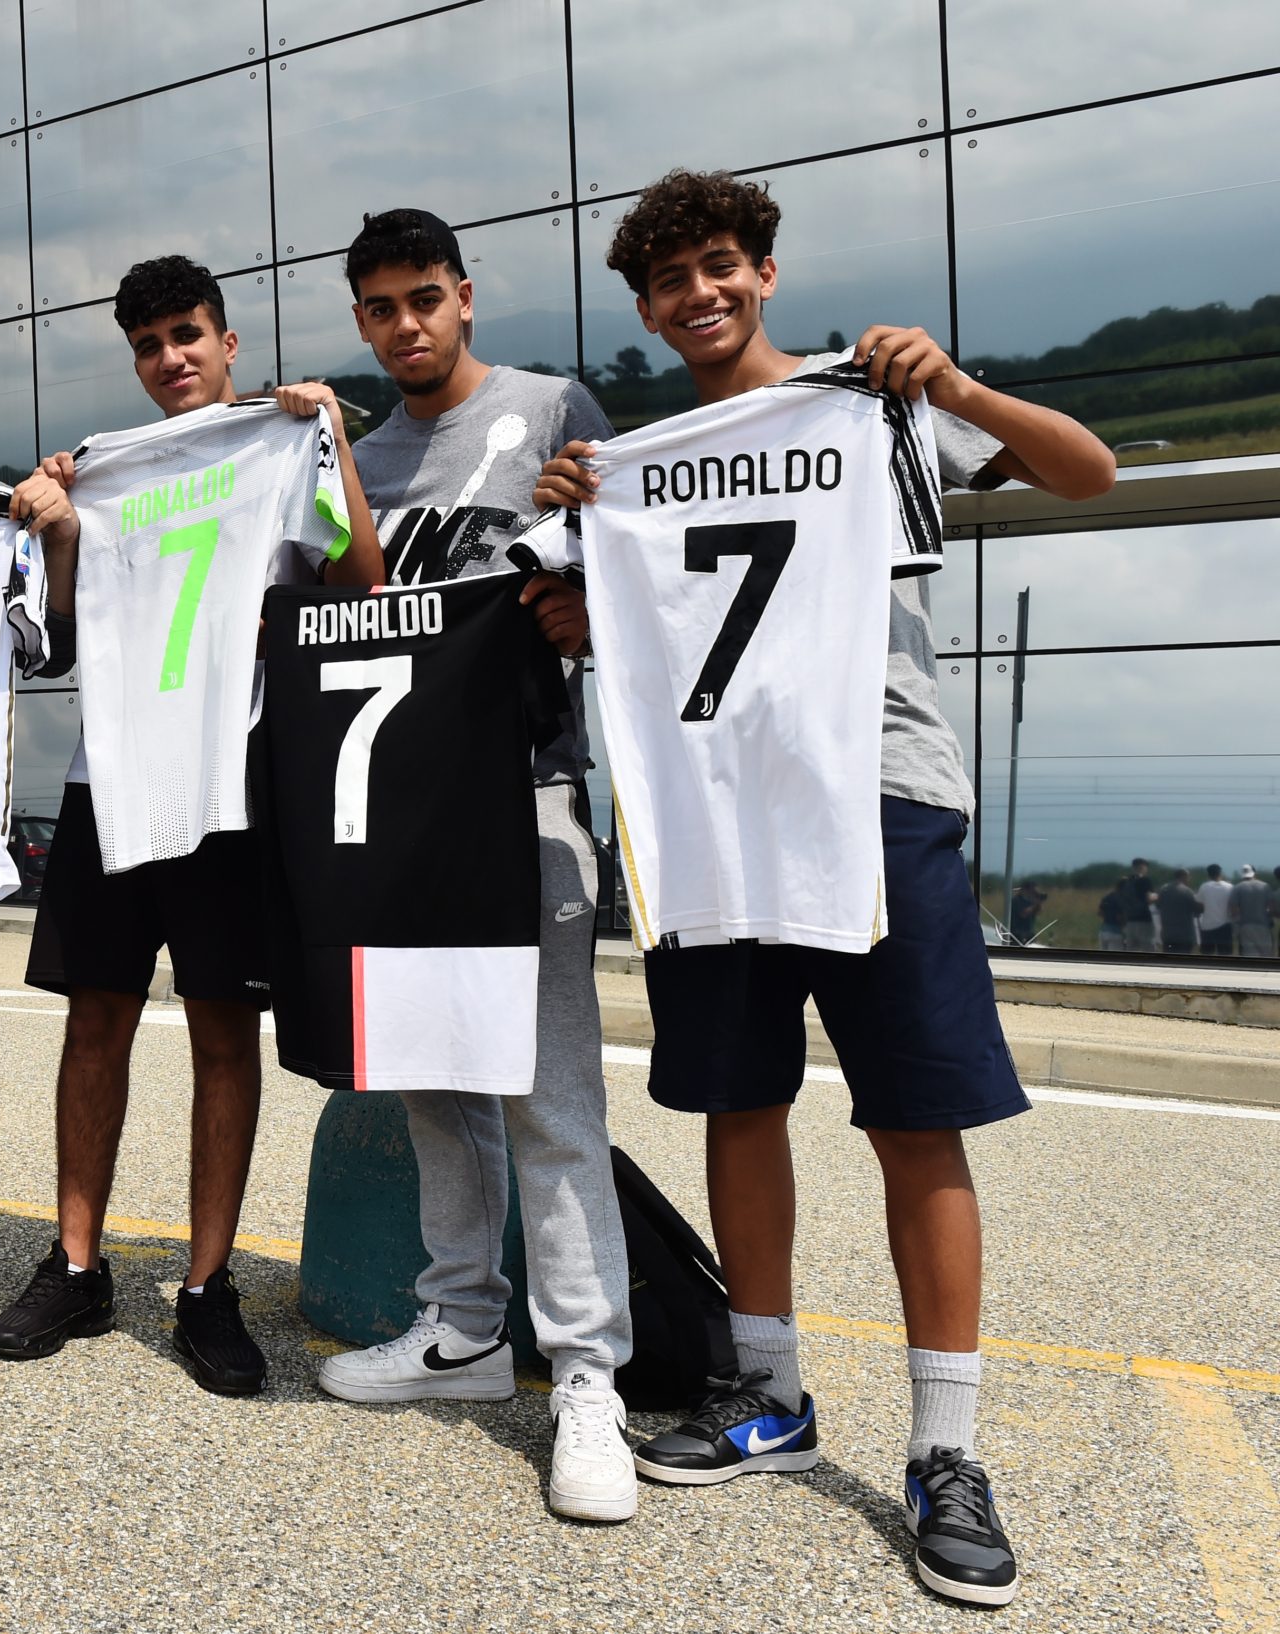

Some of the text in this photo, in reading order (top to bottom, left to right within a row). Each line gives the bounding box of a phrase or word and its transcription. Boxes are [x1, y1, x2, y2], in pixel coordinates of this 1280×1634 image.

[120, 462, 235, 536] RONALDO
[642, 447, 842, 507] RONALDO
[159, 517, 219, 692] 7
[297, 591, 443, 646] RONALDO
[680, 519, 797, 723] 7
[319, 655, 413, 844] 7
[561, 902, 584, 913] NIKE
